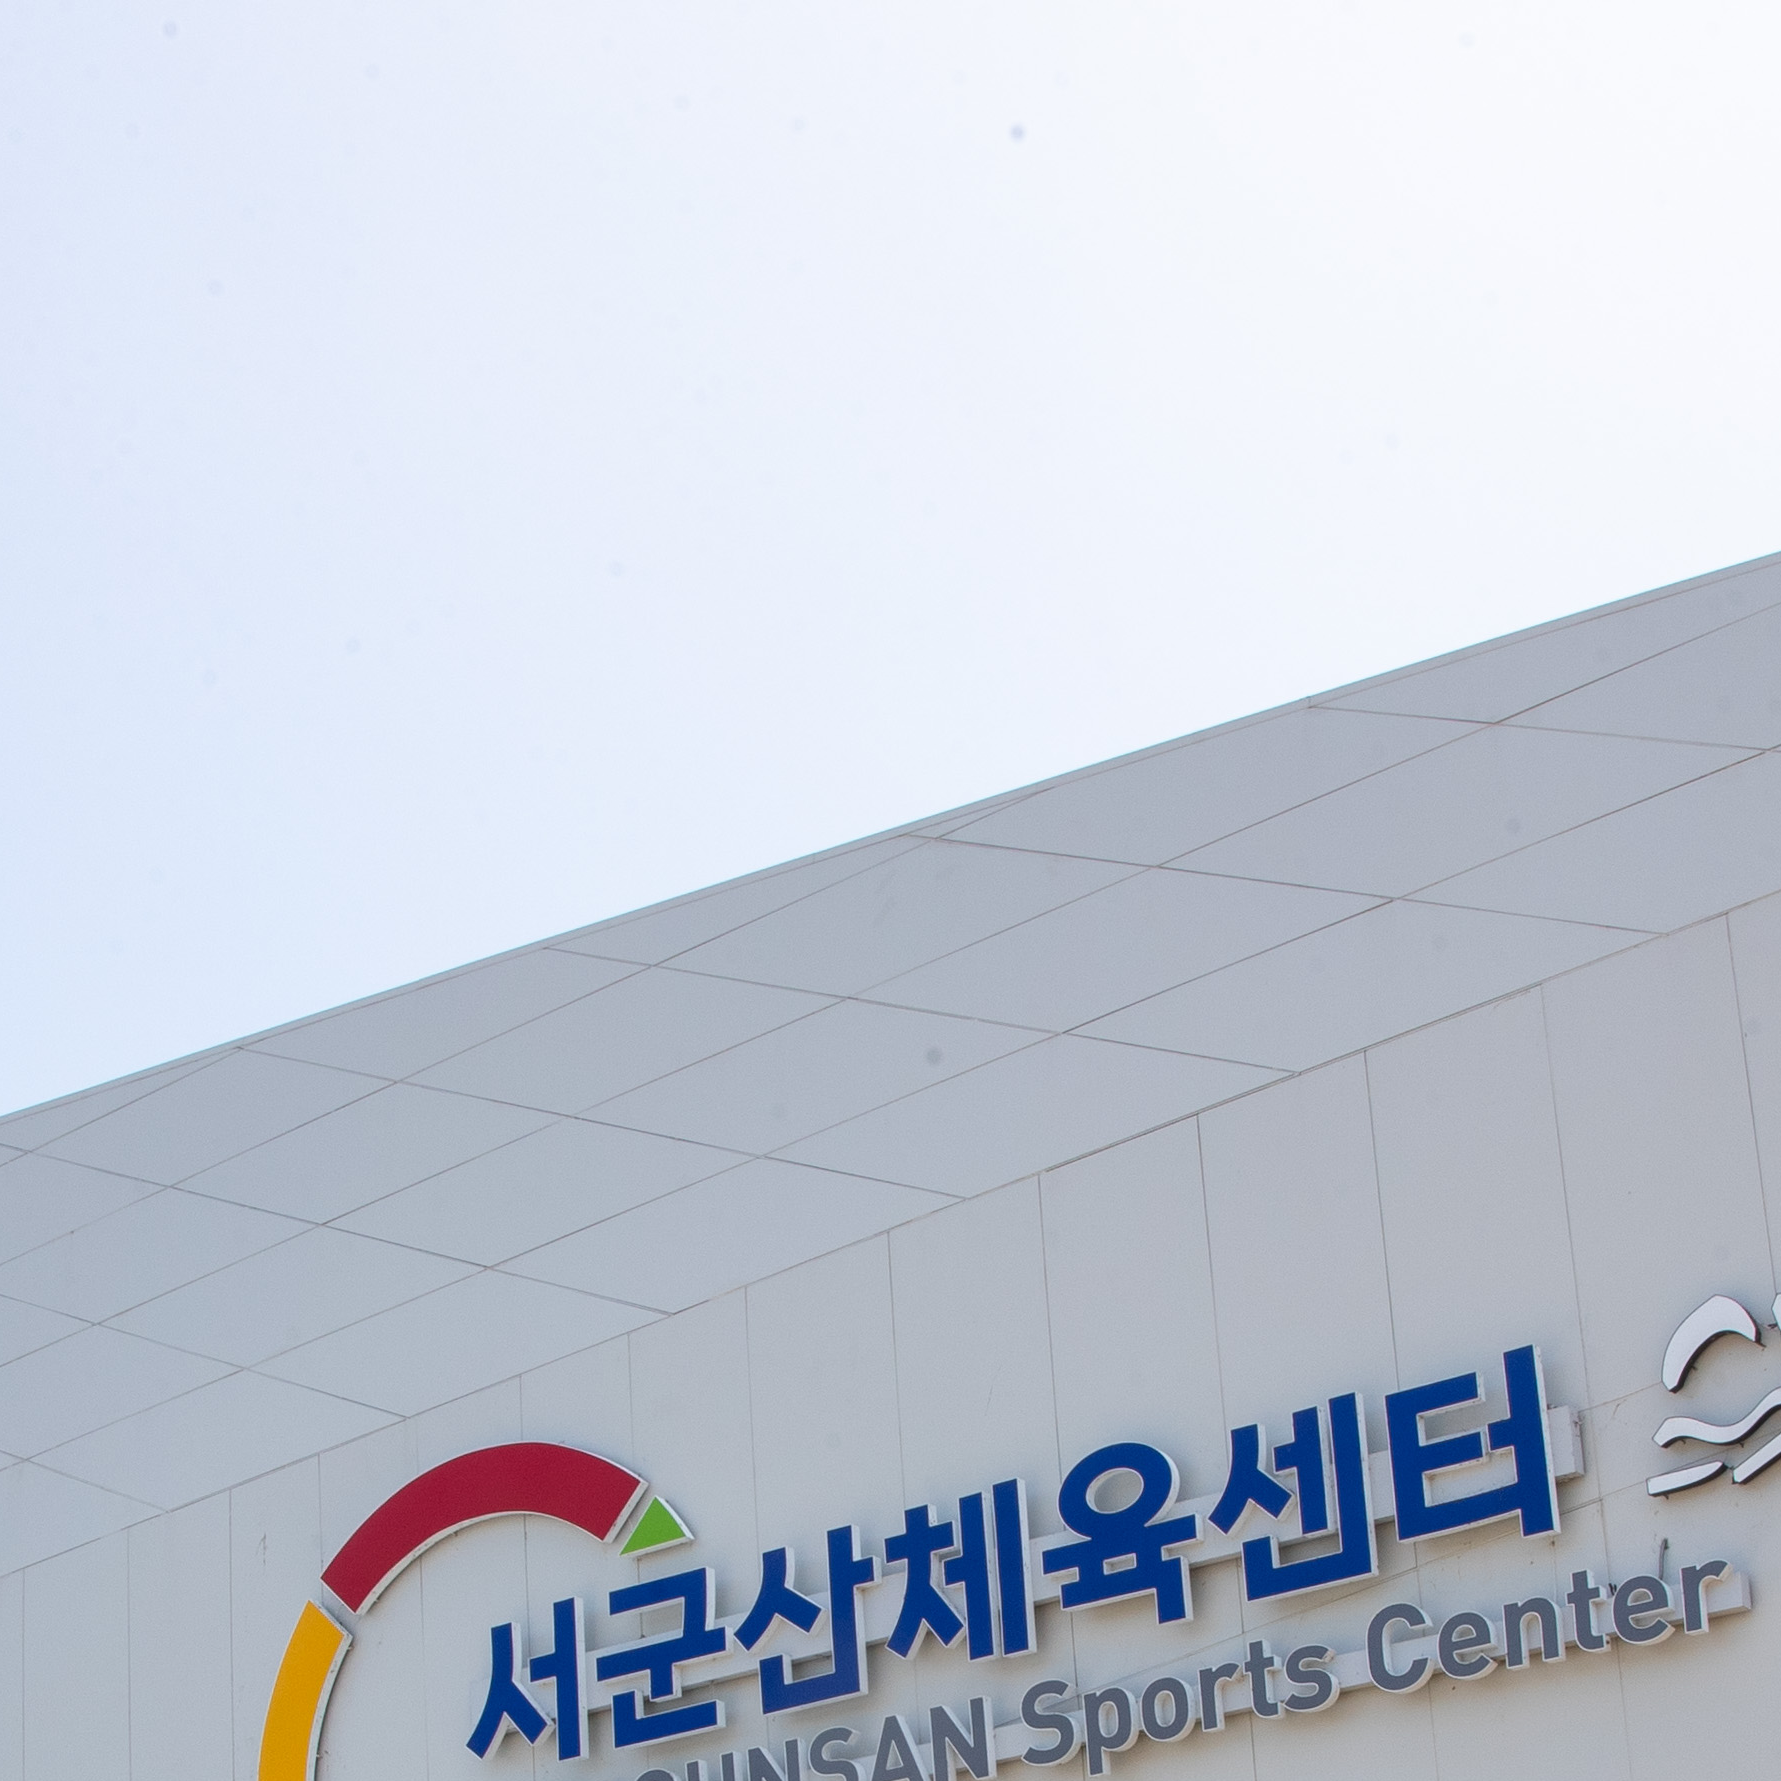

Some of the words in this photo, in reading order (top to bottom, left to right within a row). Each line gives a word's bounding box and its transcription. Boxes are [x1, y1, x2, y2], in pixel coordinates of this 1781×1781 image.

[466, 1343, 1561, 1761] 서군산체육센터
[1021, 1639, 1341, 1775] Sports
[1365, 1558, 1732, 1696] Center
